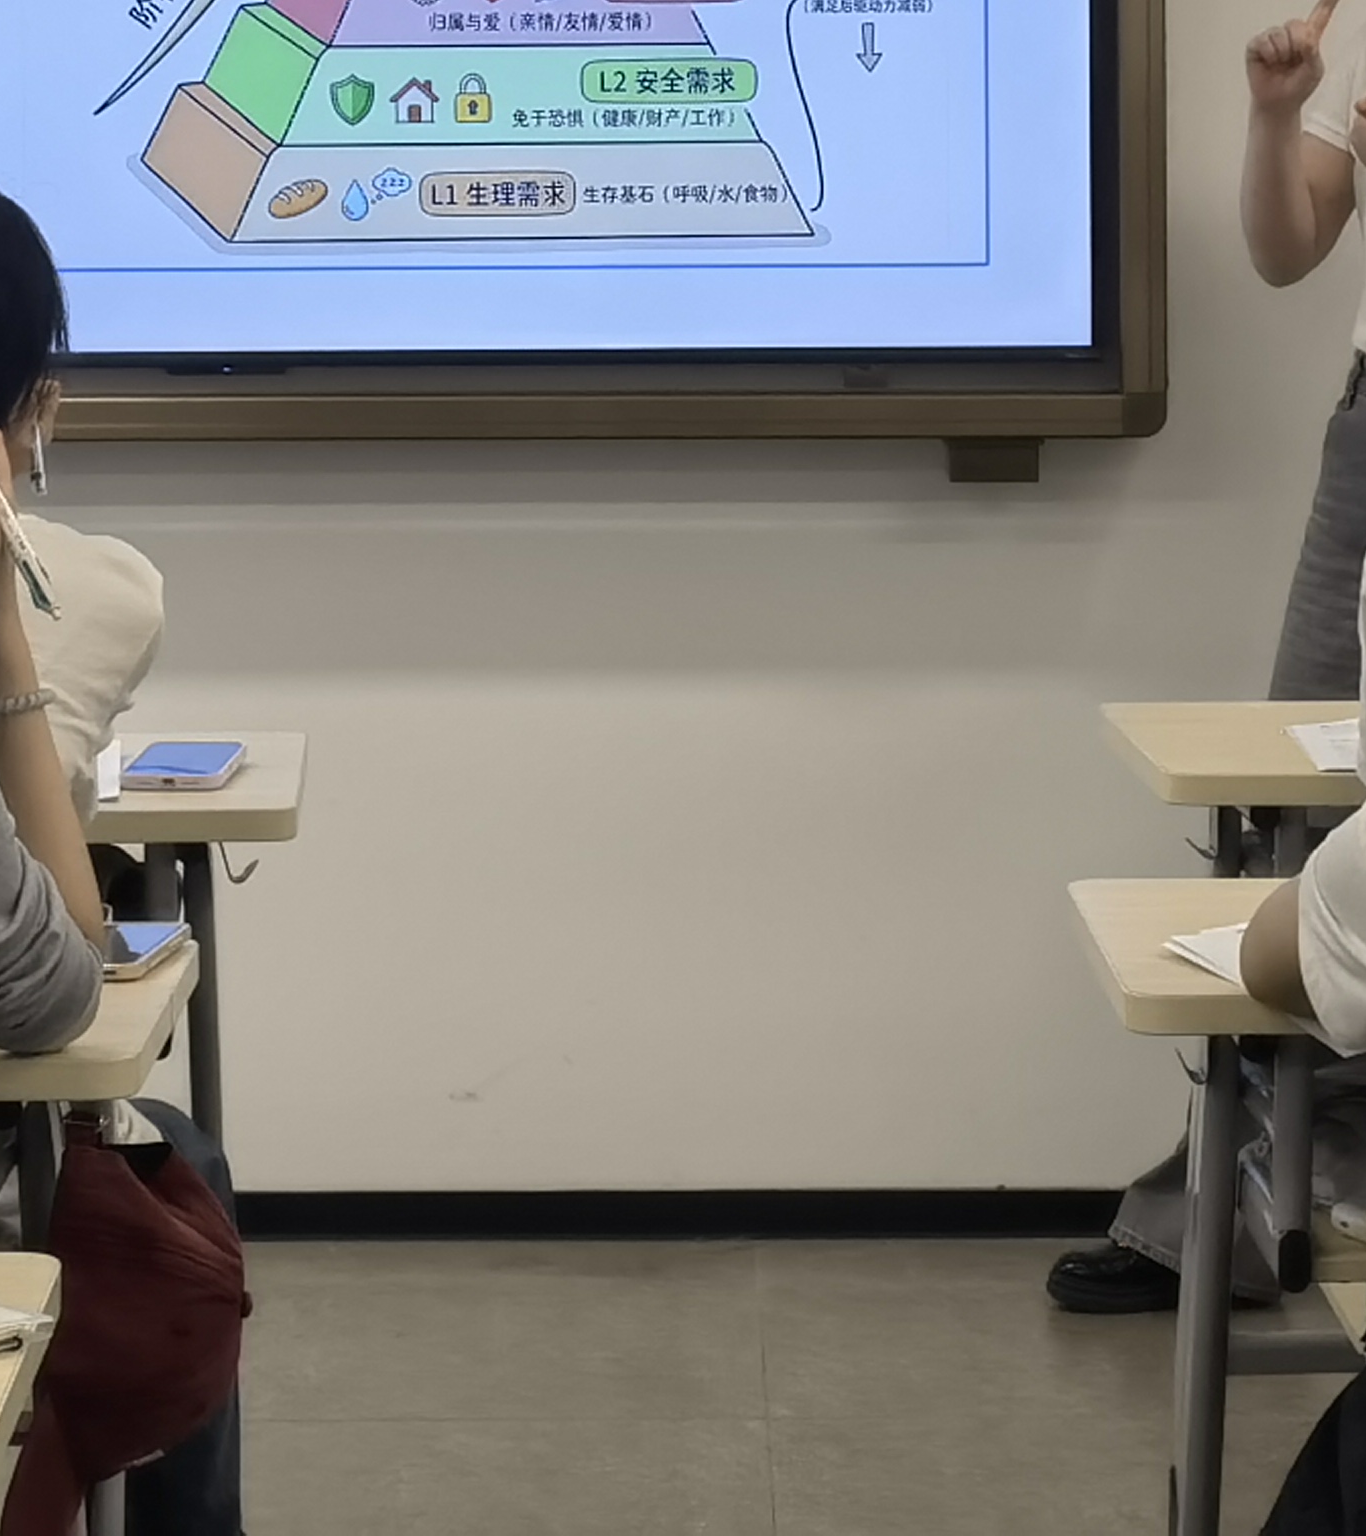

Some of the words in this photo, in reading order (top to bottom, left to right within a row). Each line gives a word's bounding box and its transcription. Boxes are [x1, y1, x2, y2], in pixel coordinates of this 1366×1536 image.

[599, 70, 627, 94] L2
[635, 66, 736, 95] 安全需求
[431, 184, 457, 206] L1
[466, 180, 566, 208] 生理需求
